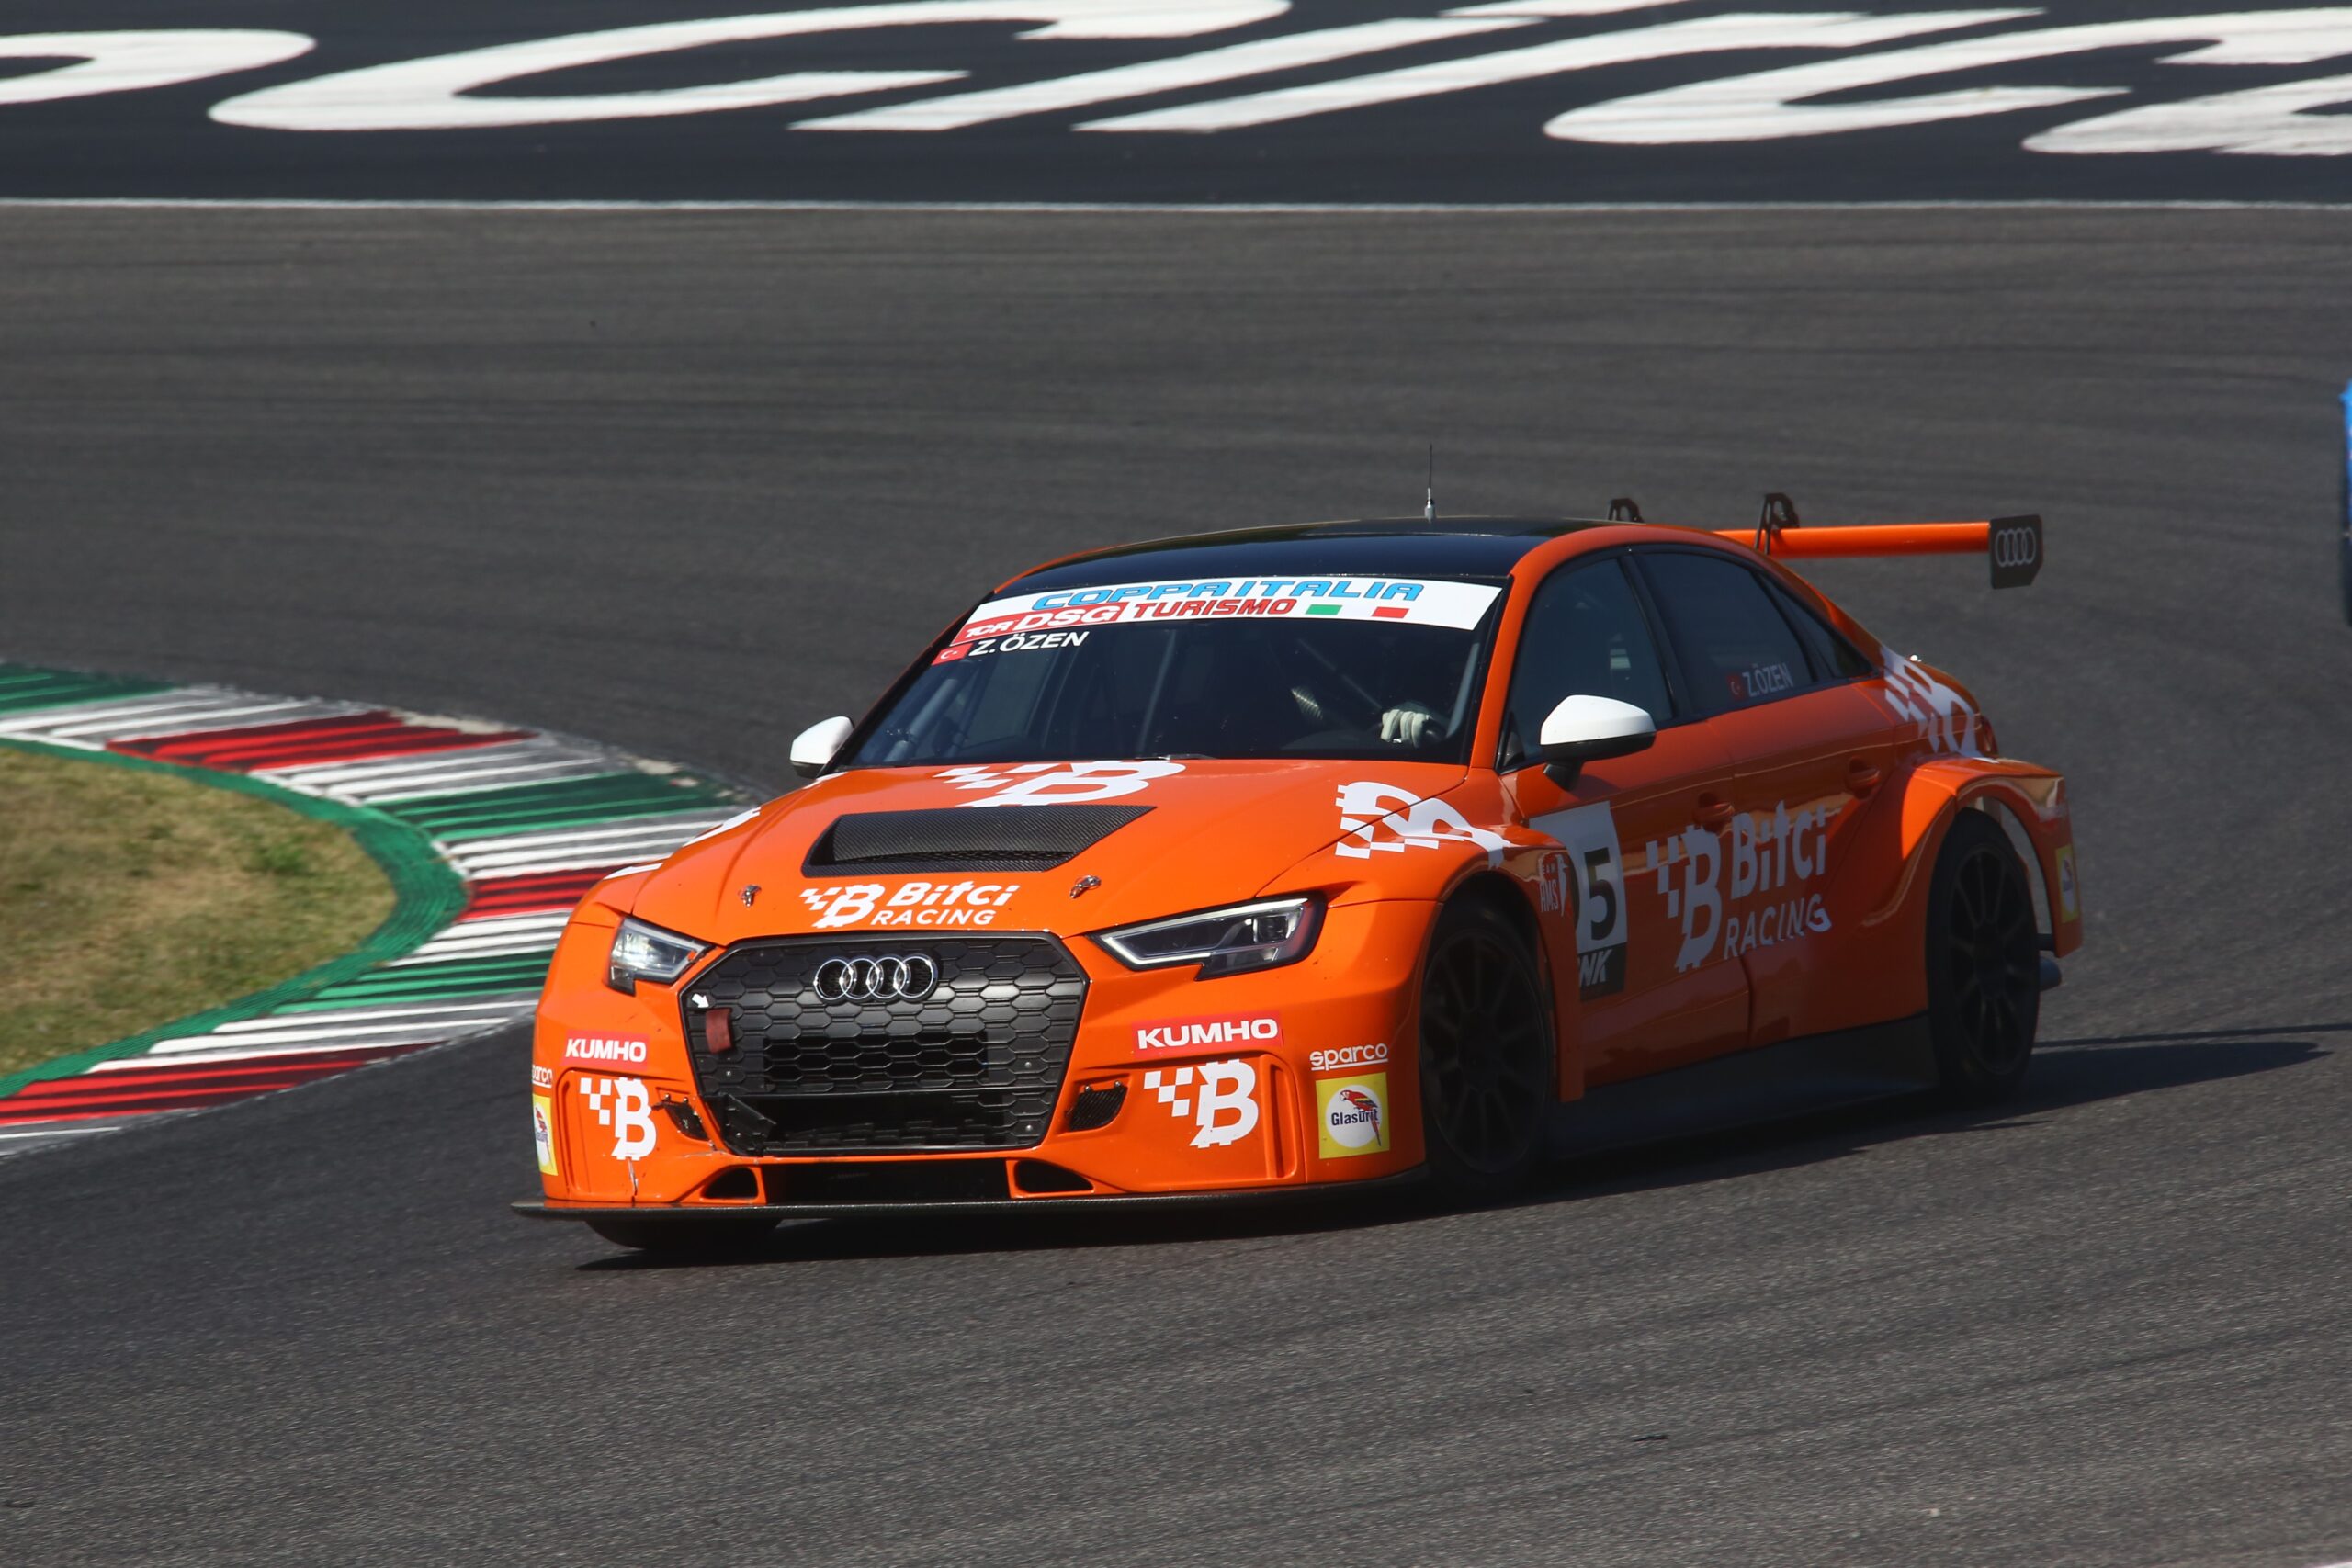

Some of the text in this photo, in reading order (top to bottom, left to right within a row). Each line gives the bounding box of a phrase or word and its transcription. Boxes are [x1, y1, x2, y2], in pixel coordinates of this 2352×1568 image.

[1012, 604, 1123, 631] DSG
[1133, 598, 1297, 619] TURISMO
[1583, 846, 1618, 942] 5
[871, 908, 998, 926] RACING
[1723, 893, 1832, 961] RACING
[1137, 1018, 1279, 1050] KUMHO
[565, 1038, 647, 1063] KUMHO
[1308, 1043, 1389, 1071] sparco
